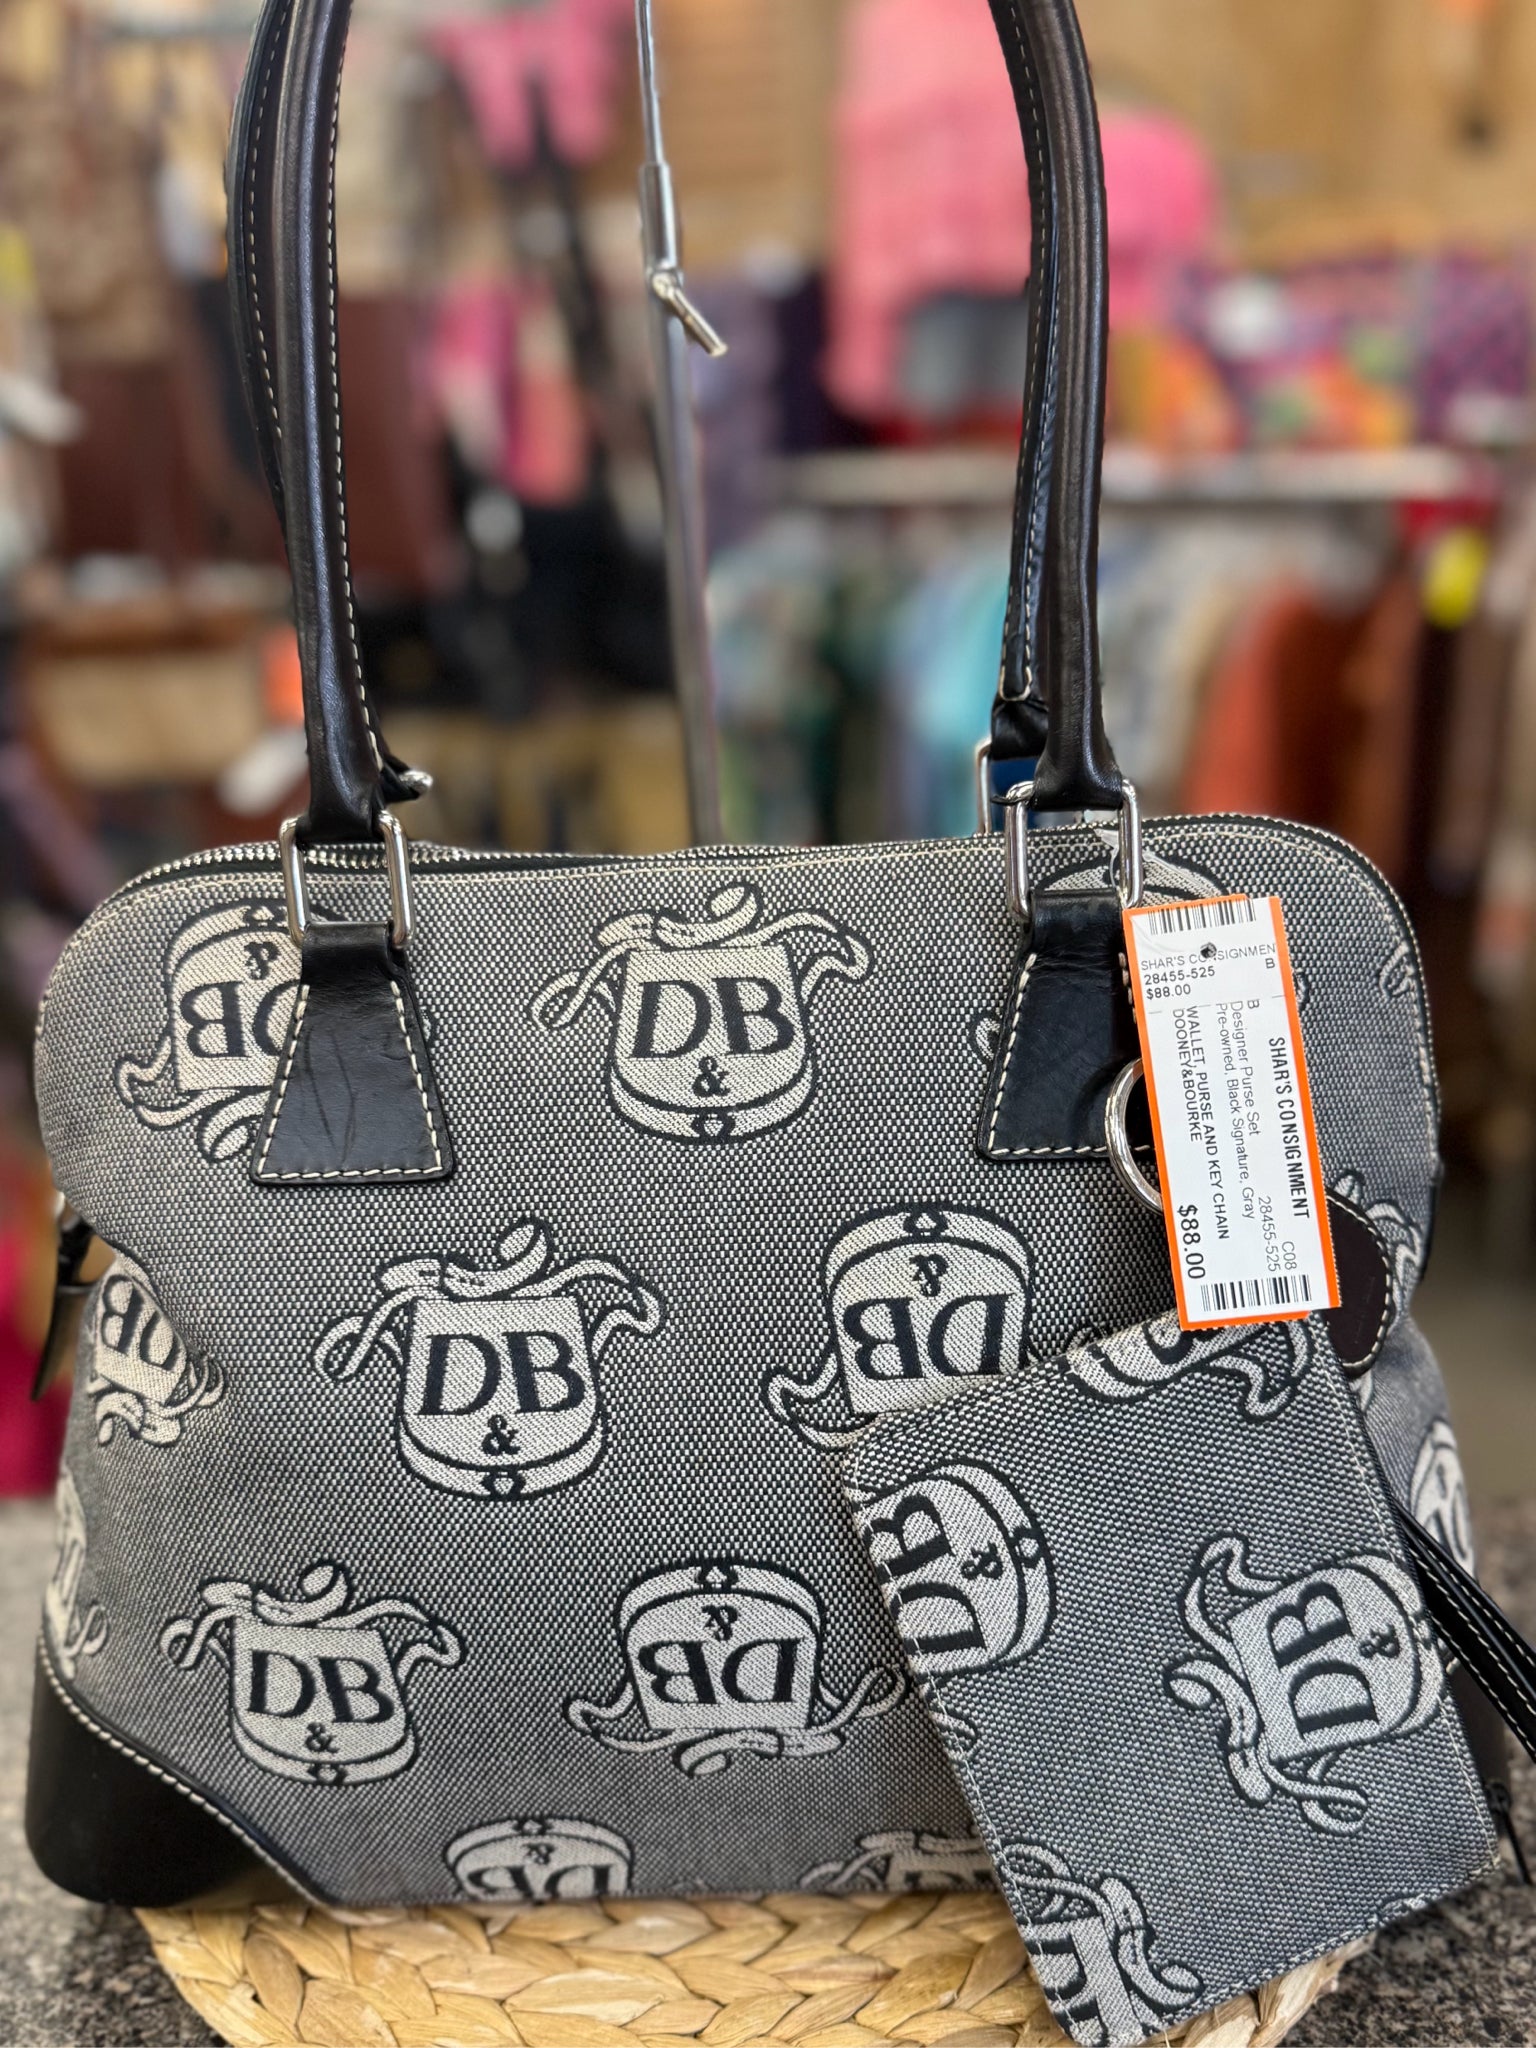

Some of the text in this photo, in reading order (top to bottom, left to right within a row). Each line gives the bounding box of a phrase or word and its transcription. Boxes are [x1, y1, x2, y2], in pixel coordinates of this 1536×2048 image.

[1141, 943, 1276, 971] SHAR'S COSIGNMEN
[1144, 965, 1216, 985] 28455-525
[1146, 984, 1191, 1000] $88.00
[1265, 957, 1276, 969] B
[632, 975, 796, 1060] DB
[1247, 999, 1260, 1009] B
[1172, 1008, 1203, 1142] DOONEY&BOURKE
[1231, 1000, 1261, 1137] Designer Purse Set
[1186, 1005, 1230, 1240] WALLET, PURSE AND KEY CHAIN
[1216, 1002, 1255, 1219] Pre-owned, Black Signature, Gray
[1268, 1037, 1310, 1219] SHAR'S CONSIGNMENT
[1177, 1204, 1206, 1279] $88.00
[1258, 1195, 1281, 1272] 28455-525
[1281, 1241, 1298, 1271] C08
[418, 1330, 590, 1418] DB
[843, 1294, 1016, 1381] DB
[247, 1649, 396, 1726] DB
[638, 1637, 808, 1705] DB
[1266, 1581, 1381, 1743] DB
